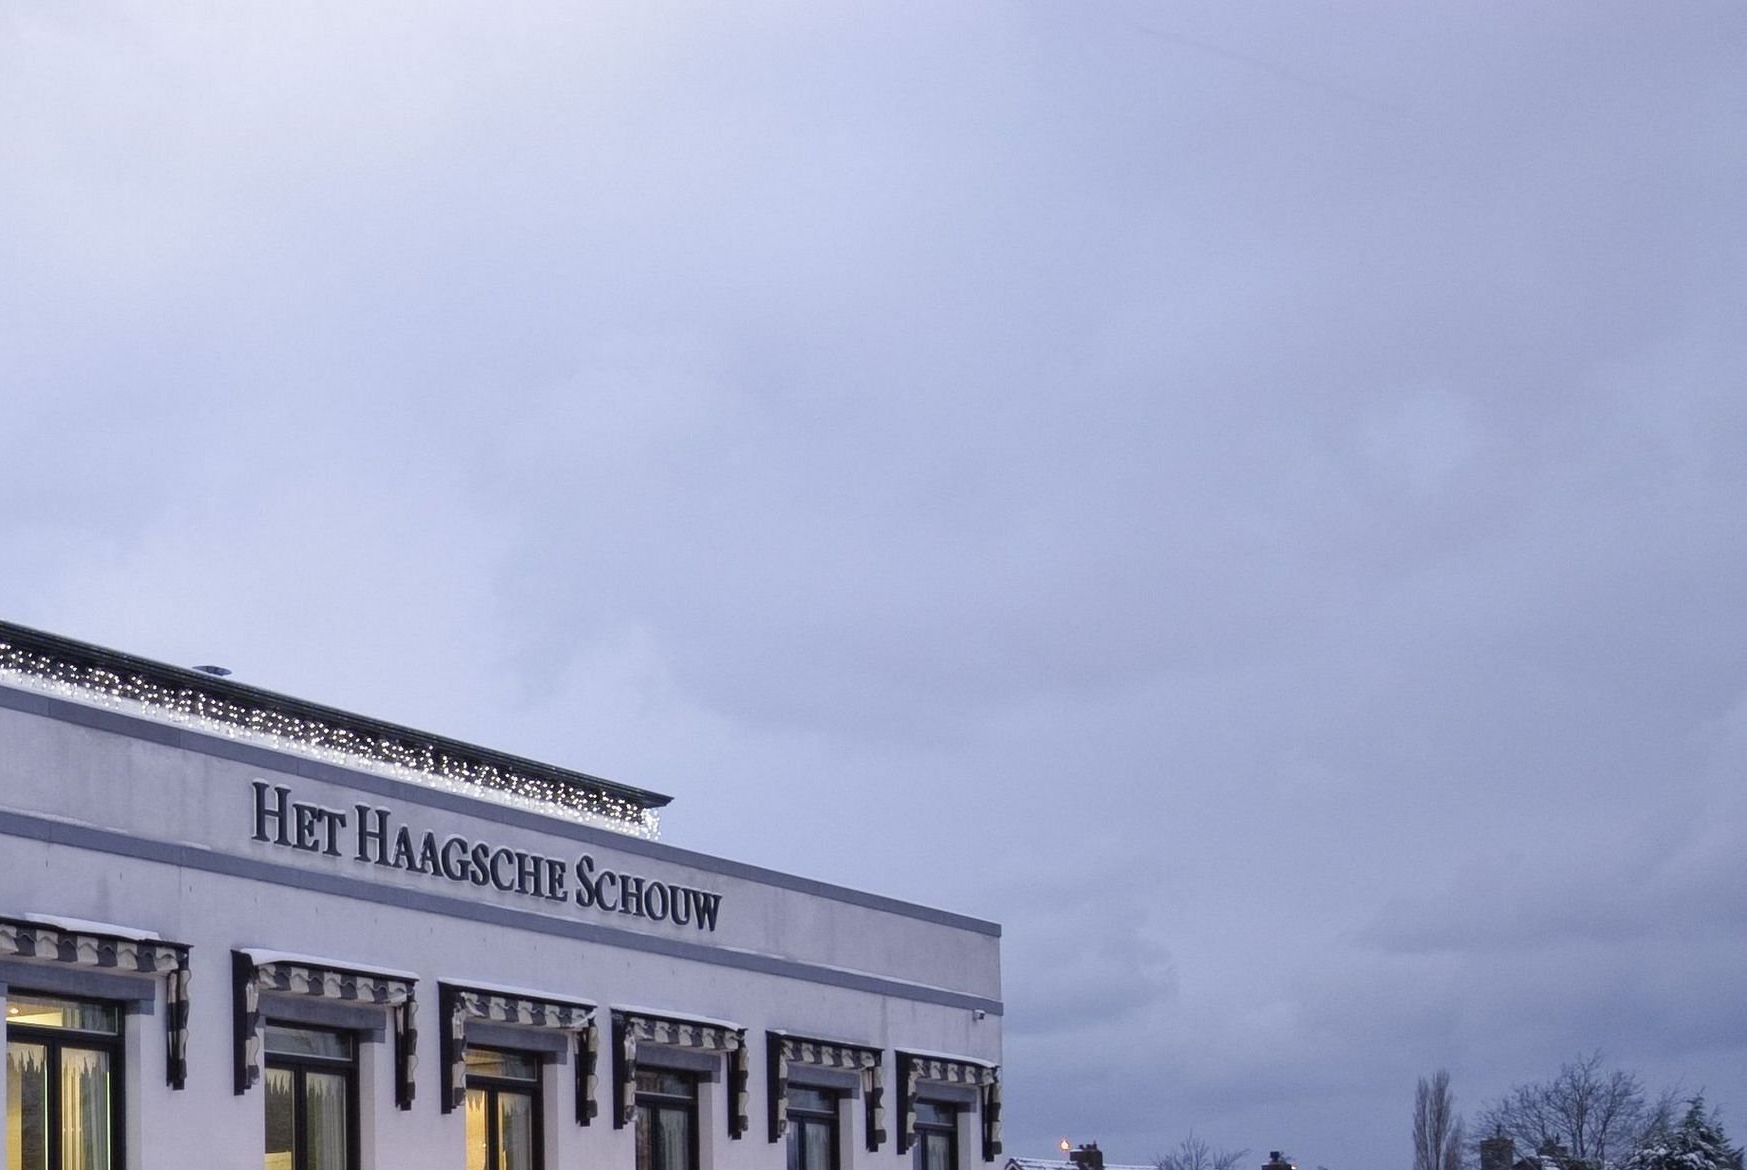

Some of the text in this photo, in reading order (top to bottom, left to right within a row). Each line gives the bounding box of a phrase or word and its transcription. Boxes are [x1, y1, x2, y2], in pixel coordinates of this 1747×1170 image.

[252, 781, 723, 932] HET HAAGSCHE SCHOUW
